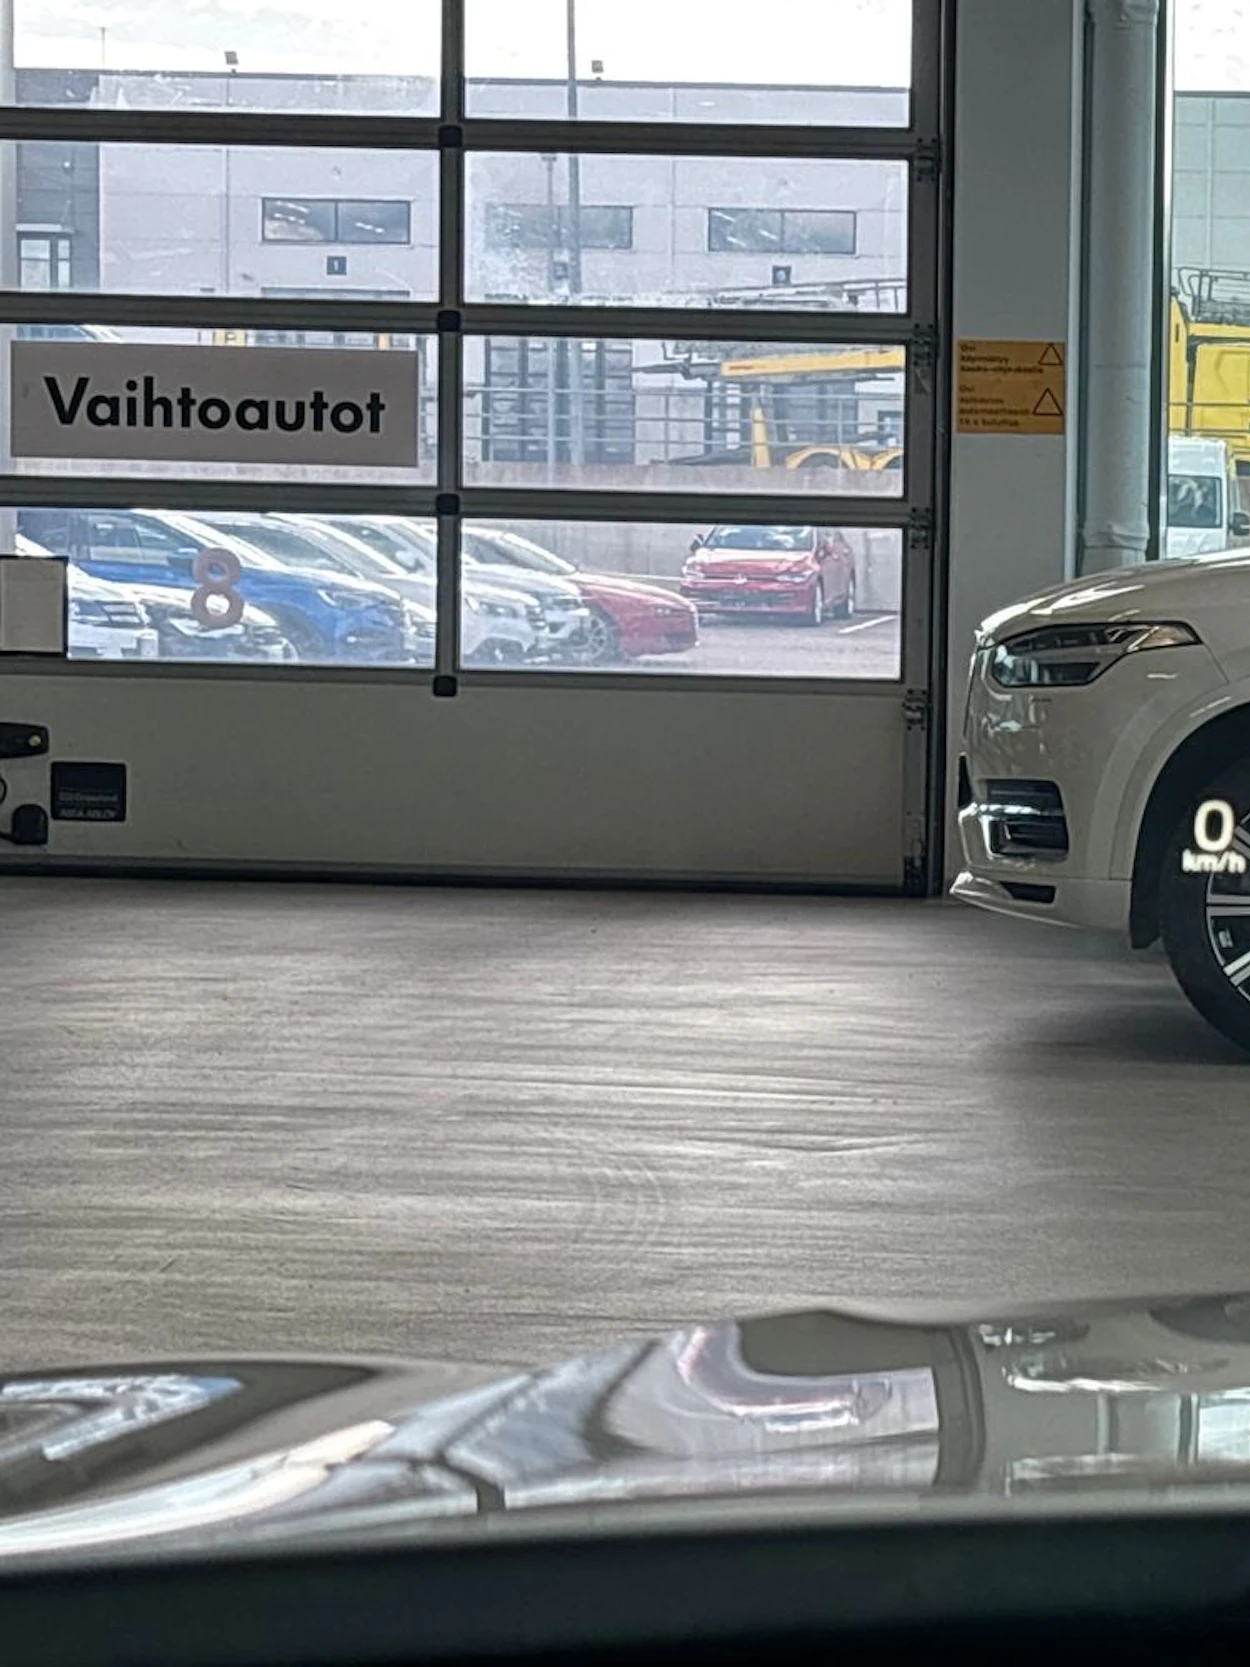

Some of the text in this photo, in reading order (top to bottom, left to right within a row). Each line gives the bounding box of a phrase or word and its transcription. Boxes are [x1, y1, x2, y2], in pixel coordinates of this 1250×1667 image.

[43, 376, 386, 433] Vaihtoautot
[190, 547, 245, 629] 8
[1194, 799, 1235, 852] 0
[1181, 848, 1247, 873] km/h
